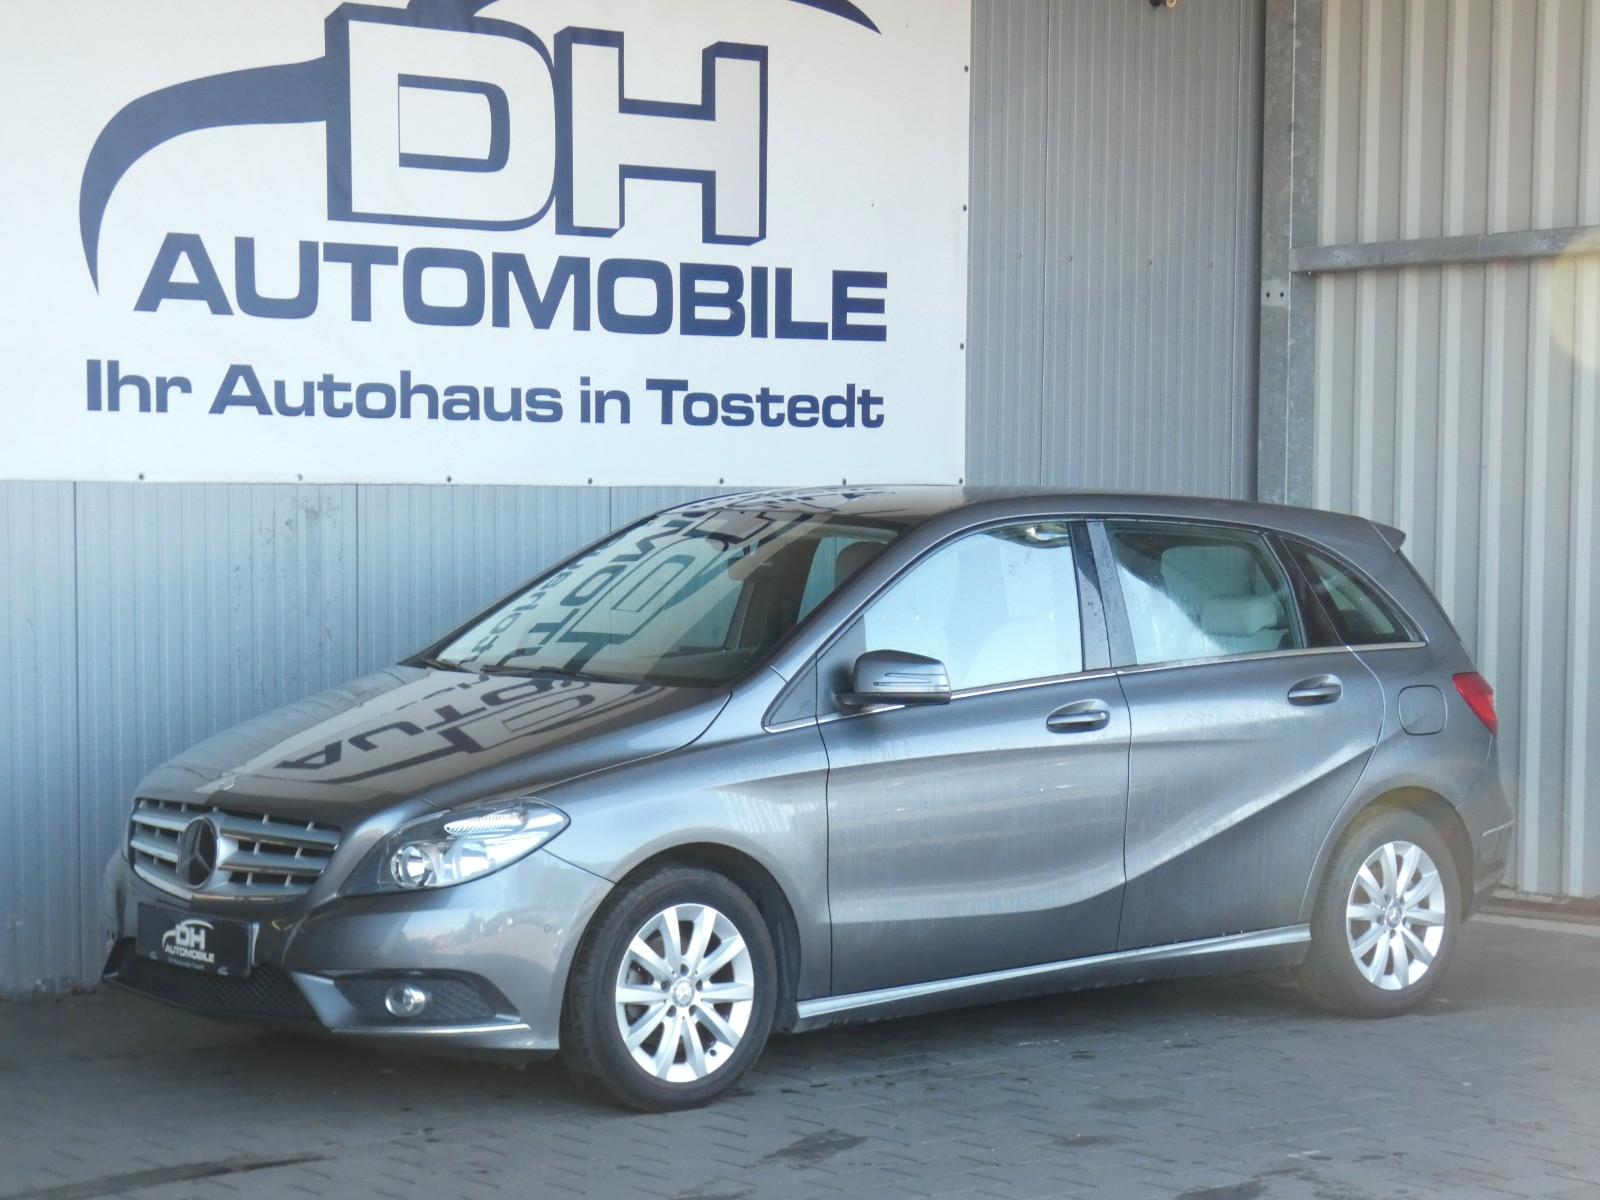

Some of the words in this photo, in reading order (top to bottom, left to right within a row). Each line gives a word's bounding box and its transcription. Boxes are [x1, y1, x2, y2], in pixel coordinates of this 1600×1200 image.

[325, 2, 768, 247] DH
[134, 232, 888, 342] AUTOMOBILE
[86, 359, 192, 413] Ihr
[208, 364, 564, 424] Autohaus
[580, 376, 631, 425] in
[646, 378, 885, 429] Tostedt
[175, 924, 206, 950] DH
